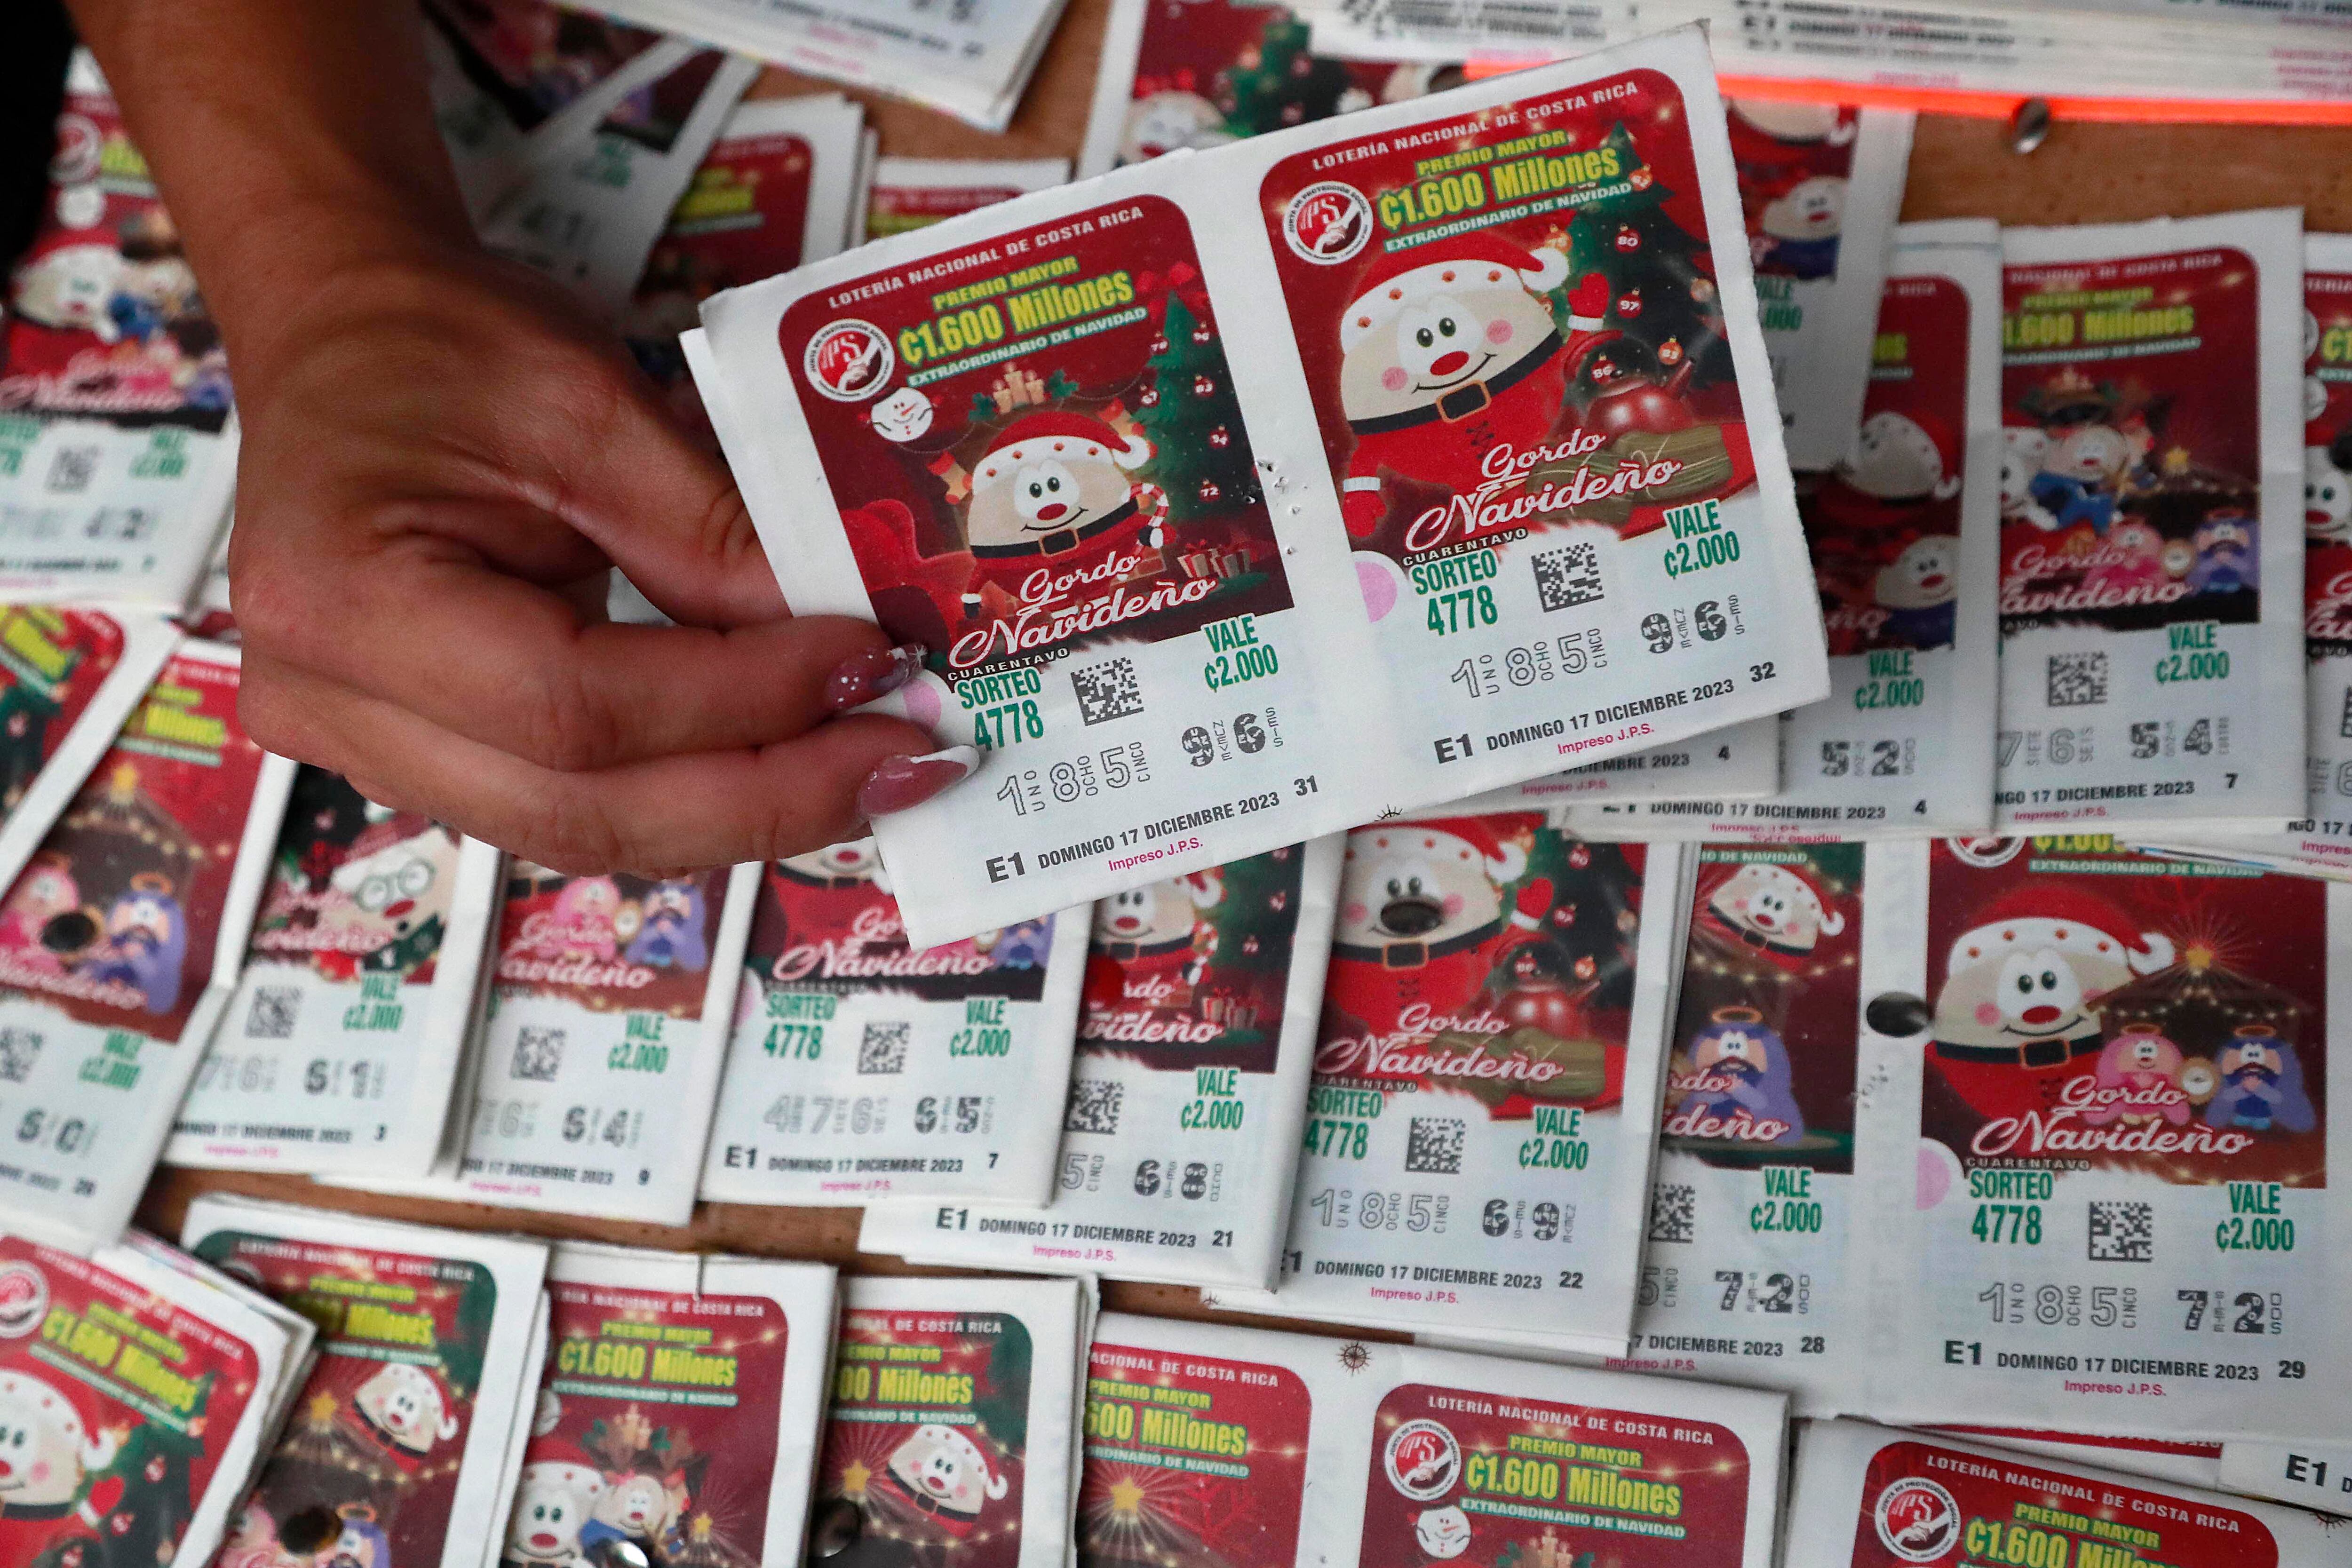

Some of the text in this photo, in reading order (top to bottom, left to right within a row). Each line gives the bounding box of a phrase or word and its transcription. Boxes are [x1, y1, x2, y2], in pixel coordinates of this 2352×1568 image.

[1312, 81, 1638, 172] LOTERÍA NACIONAL DE COSTA RICA
[1416, 127, 1566, 179] PREMIO MAYOR
[1491, 137, 1621, 204] Millones
[1385, 179, 1632, 252] EXTRAORDINARIO DE NAVIDAD
[828, 204, 1144, 309] LOTERÍA NACIONAL DE COSTA RICA
[932, 255, 1080, 311] PREMIO MAYOR
[1006, 267, 1135, 334] Millones
[907, 307, 1148, 386] EXTRAORDINARIO DE NAVIDAD
[1476, 428, 1605, 491] Gordo
[1405, 462, 1683, 551] Navideño
[1667, 501, 1722, 541] VALE
[1403, 527, 1528, 567] CUARENTAVO
[1020, 550, 1140, 608] Gordo
[1413, 550, 1498, 597] SORTEO
[950, 579, 1216, 669] Navideño
[1428, 585, 1498, 636] 4778
[1205, 614, 1259, 655] VALE
[2168, 624, 2217, 649] VALE
[947, 646, 1070, 683] CUARENTAVO
[1869, 654, 1913, 676] VALE
[957, 667, 1042, 711] SORTEO
[975, 700, 1043, 755] 4778
[1434, 662, 1775, 764] E1 DOMINGO 17 DICIEMBRE 2023 32
[1558, 724, 1654, 754] Impreso J.P.S.
[2033, 774, 2237, 802] 17 DICIEMBRE 2023 7
[986, 776, 1318, 883] E1 DOMINGO 17 DICIEMBRE 2023 31
[1754, 801, 1927, 819] DICIEMBRE 2023 4
[1109, 838, 1202, 871] Impreso J.P.S.
[766, 994, 836, 1020] SORTEO
[966, 999, 1005, 1025] VALE
[1392, 1001, 1510, 1045] Gordo
[764, 1025, 824, 1059] 4778
[1313, 1035, 1564, 1081] Navideño
[1197, 1069, 1238, 1097] VALE
[2050, 1075, 2187, 1116] Gordo
[1535, 1108, 1581, 1137] VALE
[1972, 1109, 2253, 1155] Navideño
[725, 1146, 998, 1173] E1 DOMINGO 17 DICIEMBRE 2023 7
[1966, 1155, 2090, 1171] CUARENTAVO
[1764, 1168, 1812, 1198] VALE
[1970, 1172, 2052, 1201] SORTEO
[2229, 1184, 2281, 1214] VALE
[936, 1208, 1233, 1247] E1 DOMINGO 17 DICIEMBRE 2023 21
[1971, 1203, 2042, 1244] 4778
[1315, 1260, 1583, 1290] DOMINGO 17 DICIEMBRE 2023 22
[1371, 1288, 1422, 1302] Impreso
[1649, 1335, 1825, 1357] DICIEMBRE 2023 28
[1945, 1341, 2303, 1380] E1 DOMINGO 17 DICIEMBRE 2023 29
[1185, 1365, 1279, 1387] COSTA RICA
[2065, 1381, 2166, 1396] Impreso J.P.S.
[1140, 1409, 1248, 1457] Millones
[1428, 1394, 1714, 1445] LOTERÍA NACIONAL DE COSTA RICA
[1510, 1436, 1642, 1467] PREMIO MAYOR
[2286, 1455, 2327, 1487] E1
[1567, 1466, 1683, 1517] Millones
[1926, 1453, 2241, 1533] LOTERÍA NACIONAL DE COSTA RICA
[1461, 1499, 1686, 1539] EXTRAORDINARIO DE NAVIDAD
[2014, 1503, 2161, 1549] PREMIO MAYOR
